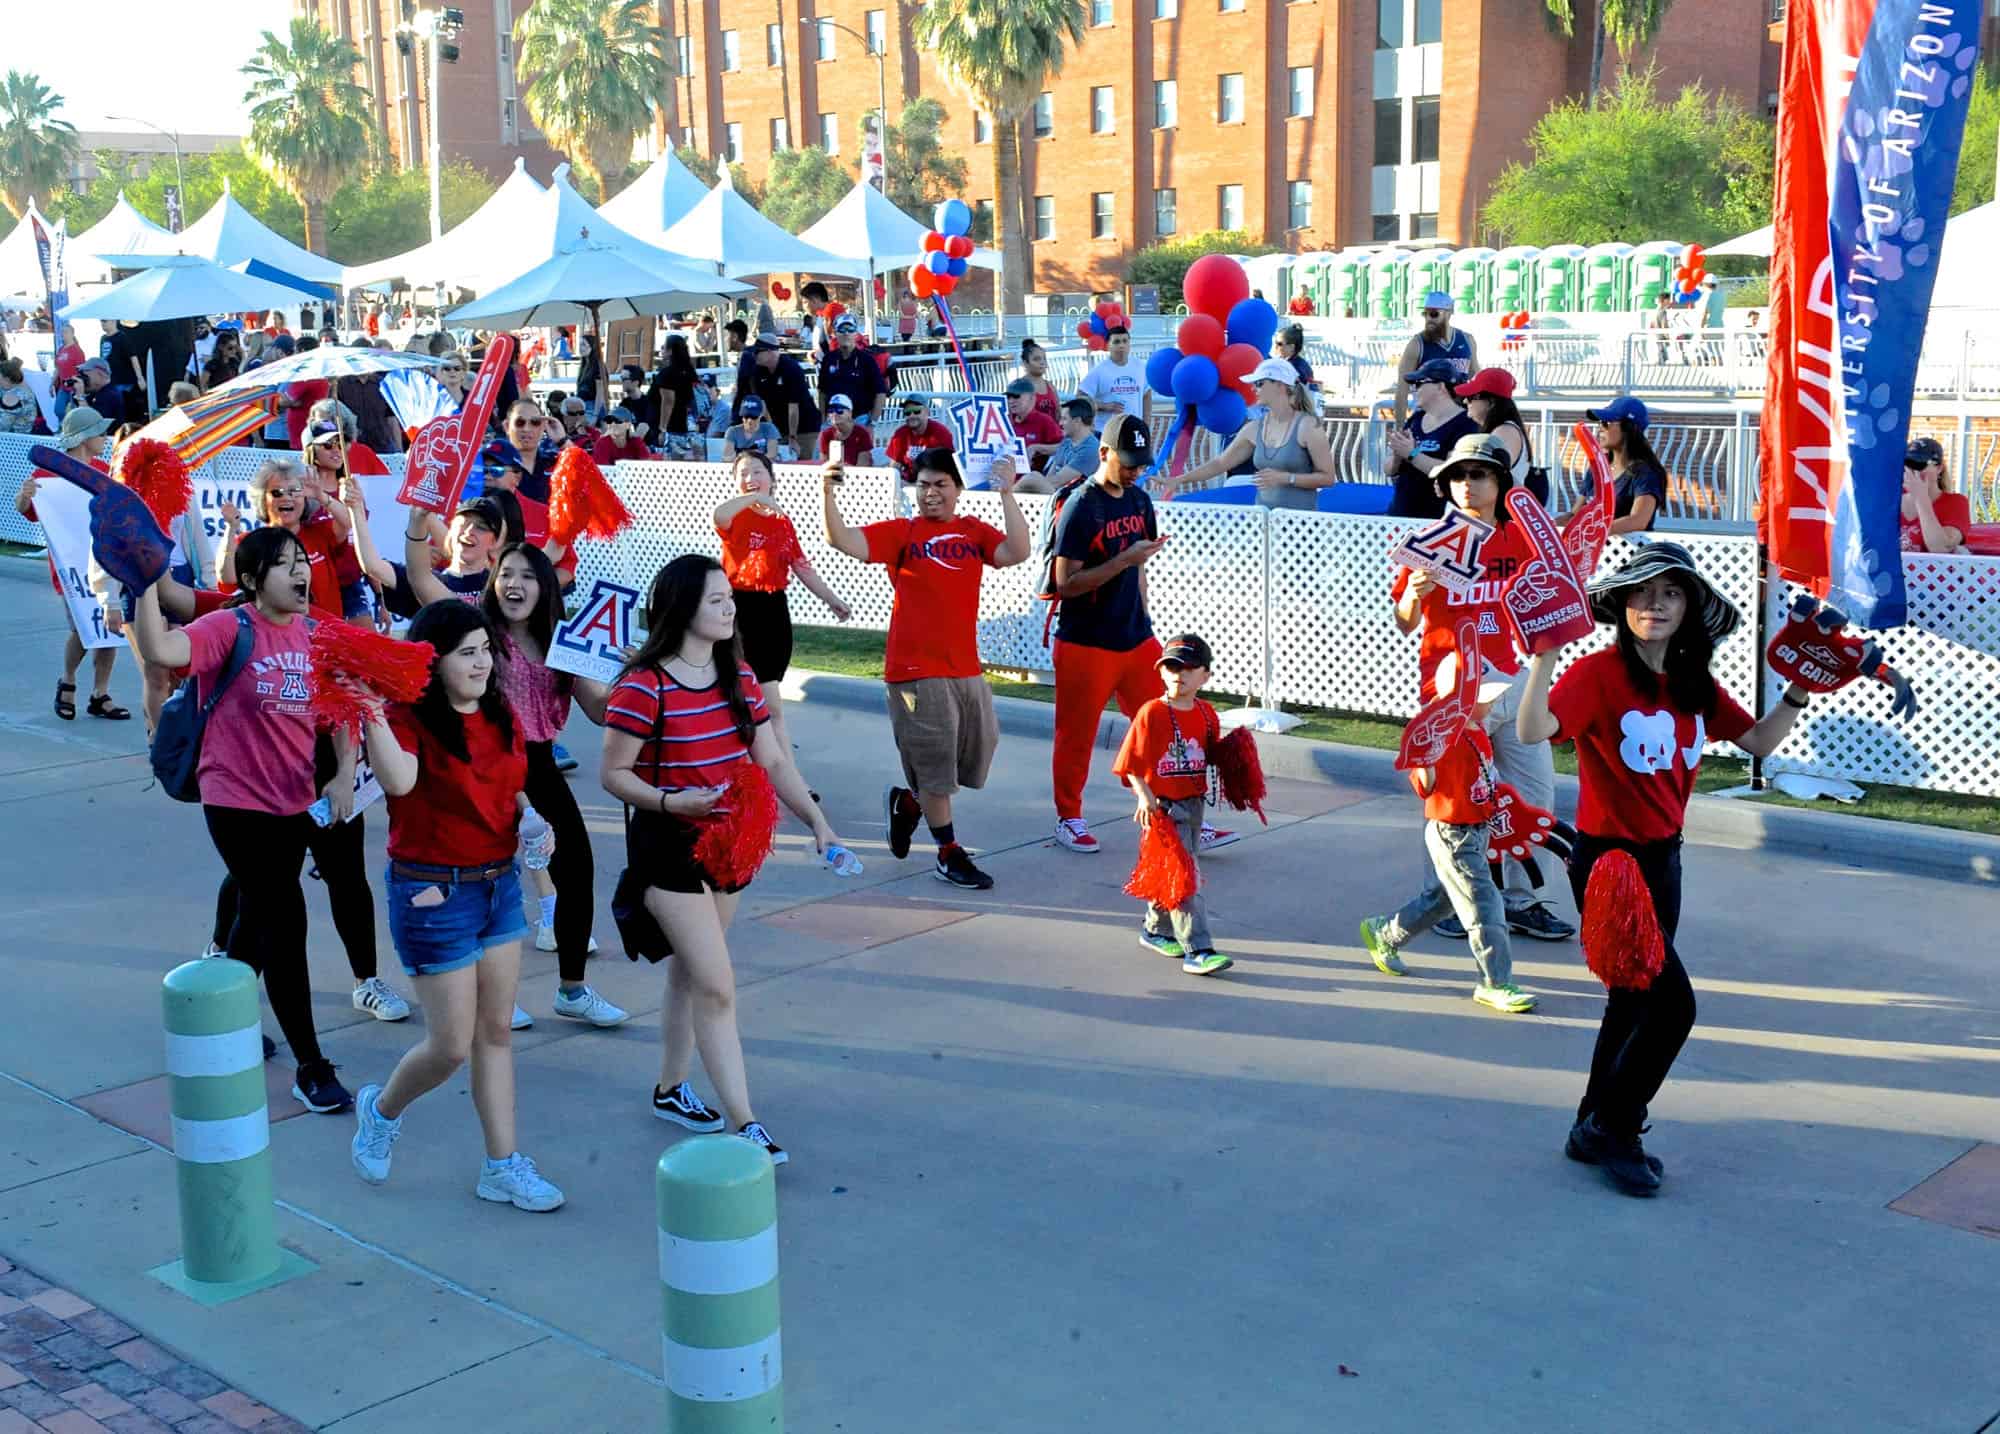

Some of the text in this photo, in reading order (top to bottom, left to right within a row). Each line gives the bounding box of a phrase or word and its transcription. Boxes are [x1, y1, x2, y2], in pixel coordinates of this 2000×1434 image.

[1863, 177, 1900, 225] OF
[968, 394, 1024, 455] A
[1134, 430, 1146, 447] LA
[1405, 510, 1492, 579] A
[1515, 497, 1563, 568] WILDCATS
[908, 541, 985, 561] ARIZON
[556, 579, 640, 664] A
[1478, 612, 1500, 634] A
[1521, 602, 1582, 631] TRANSFER
[1775, 644, 1799, 664] GO
[279, 671, 310, 700] A
